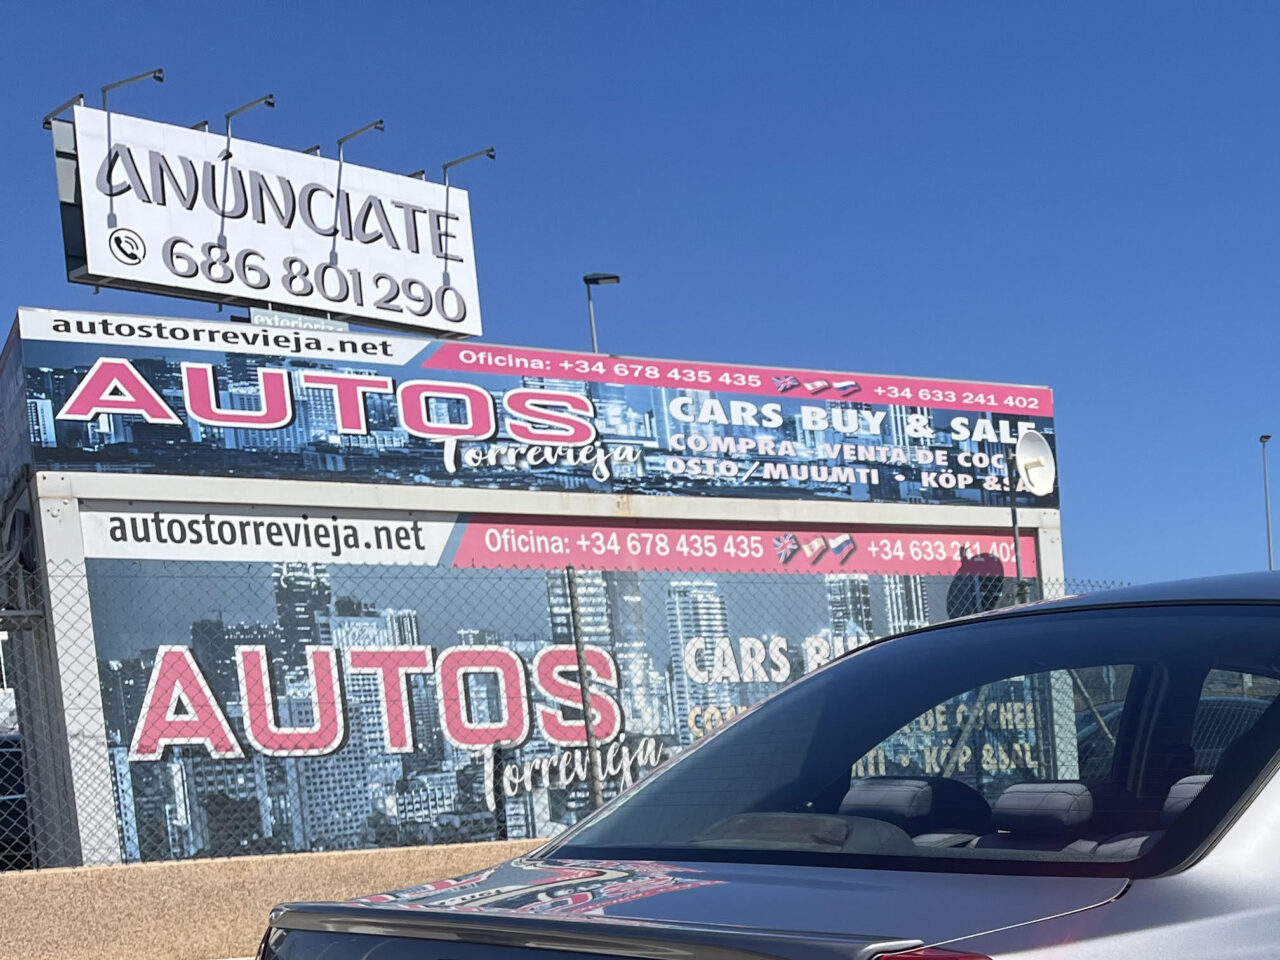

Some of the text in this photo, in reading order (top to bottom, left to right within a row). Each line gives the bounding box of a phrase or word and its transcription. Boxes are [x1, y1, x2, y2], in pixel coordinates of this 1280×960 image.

[162, 236, 467, 323] 686 801 290
[52, 317, 394, 358] autostorrevieja.net
[458, 349, 762, 388] Oficina: +34 678 435 435
[57, 356, 598, 447] AUTOS
[668, 396, 784, 428] CARS
[800, 405, 888, 434] BUY
[905, 413, 935, 439] &
[874, 386, 1040, 409] +34 633 241 402
[433, 431, 644, 483] Torrevieja
[669, 433, 797, 457] COMPRA
[824, 442, 908, 465] VENTA
[917, 448, 949, 466] DE
[921, 468, 974, 489] KÖP
[109, 512, 426, 556] autostorrevieja.net
[484, 527, 764, 558] Oficina: +34 678 435 435
[868, 538, 905, 561] +34
[909, 540, 947, 561] 633
[684, 636, 791, 684] CARS
[128, 644, 626, 762] AUTOS
